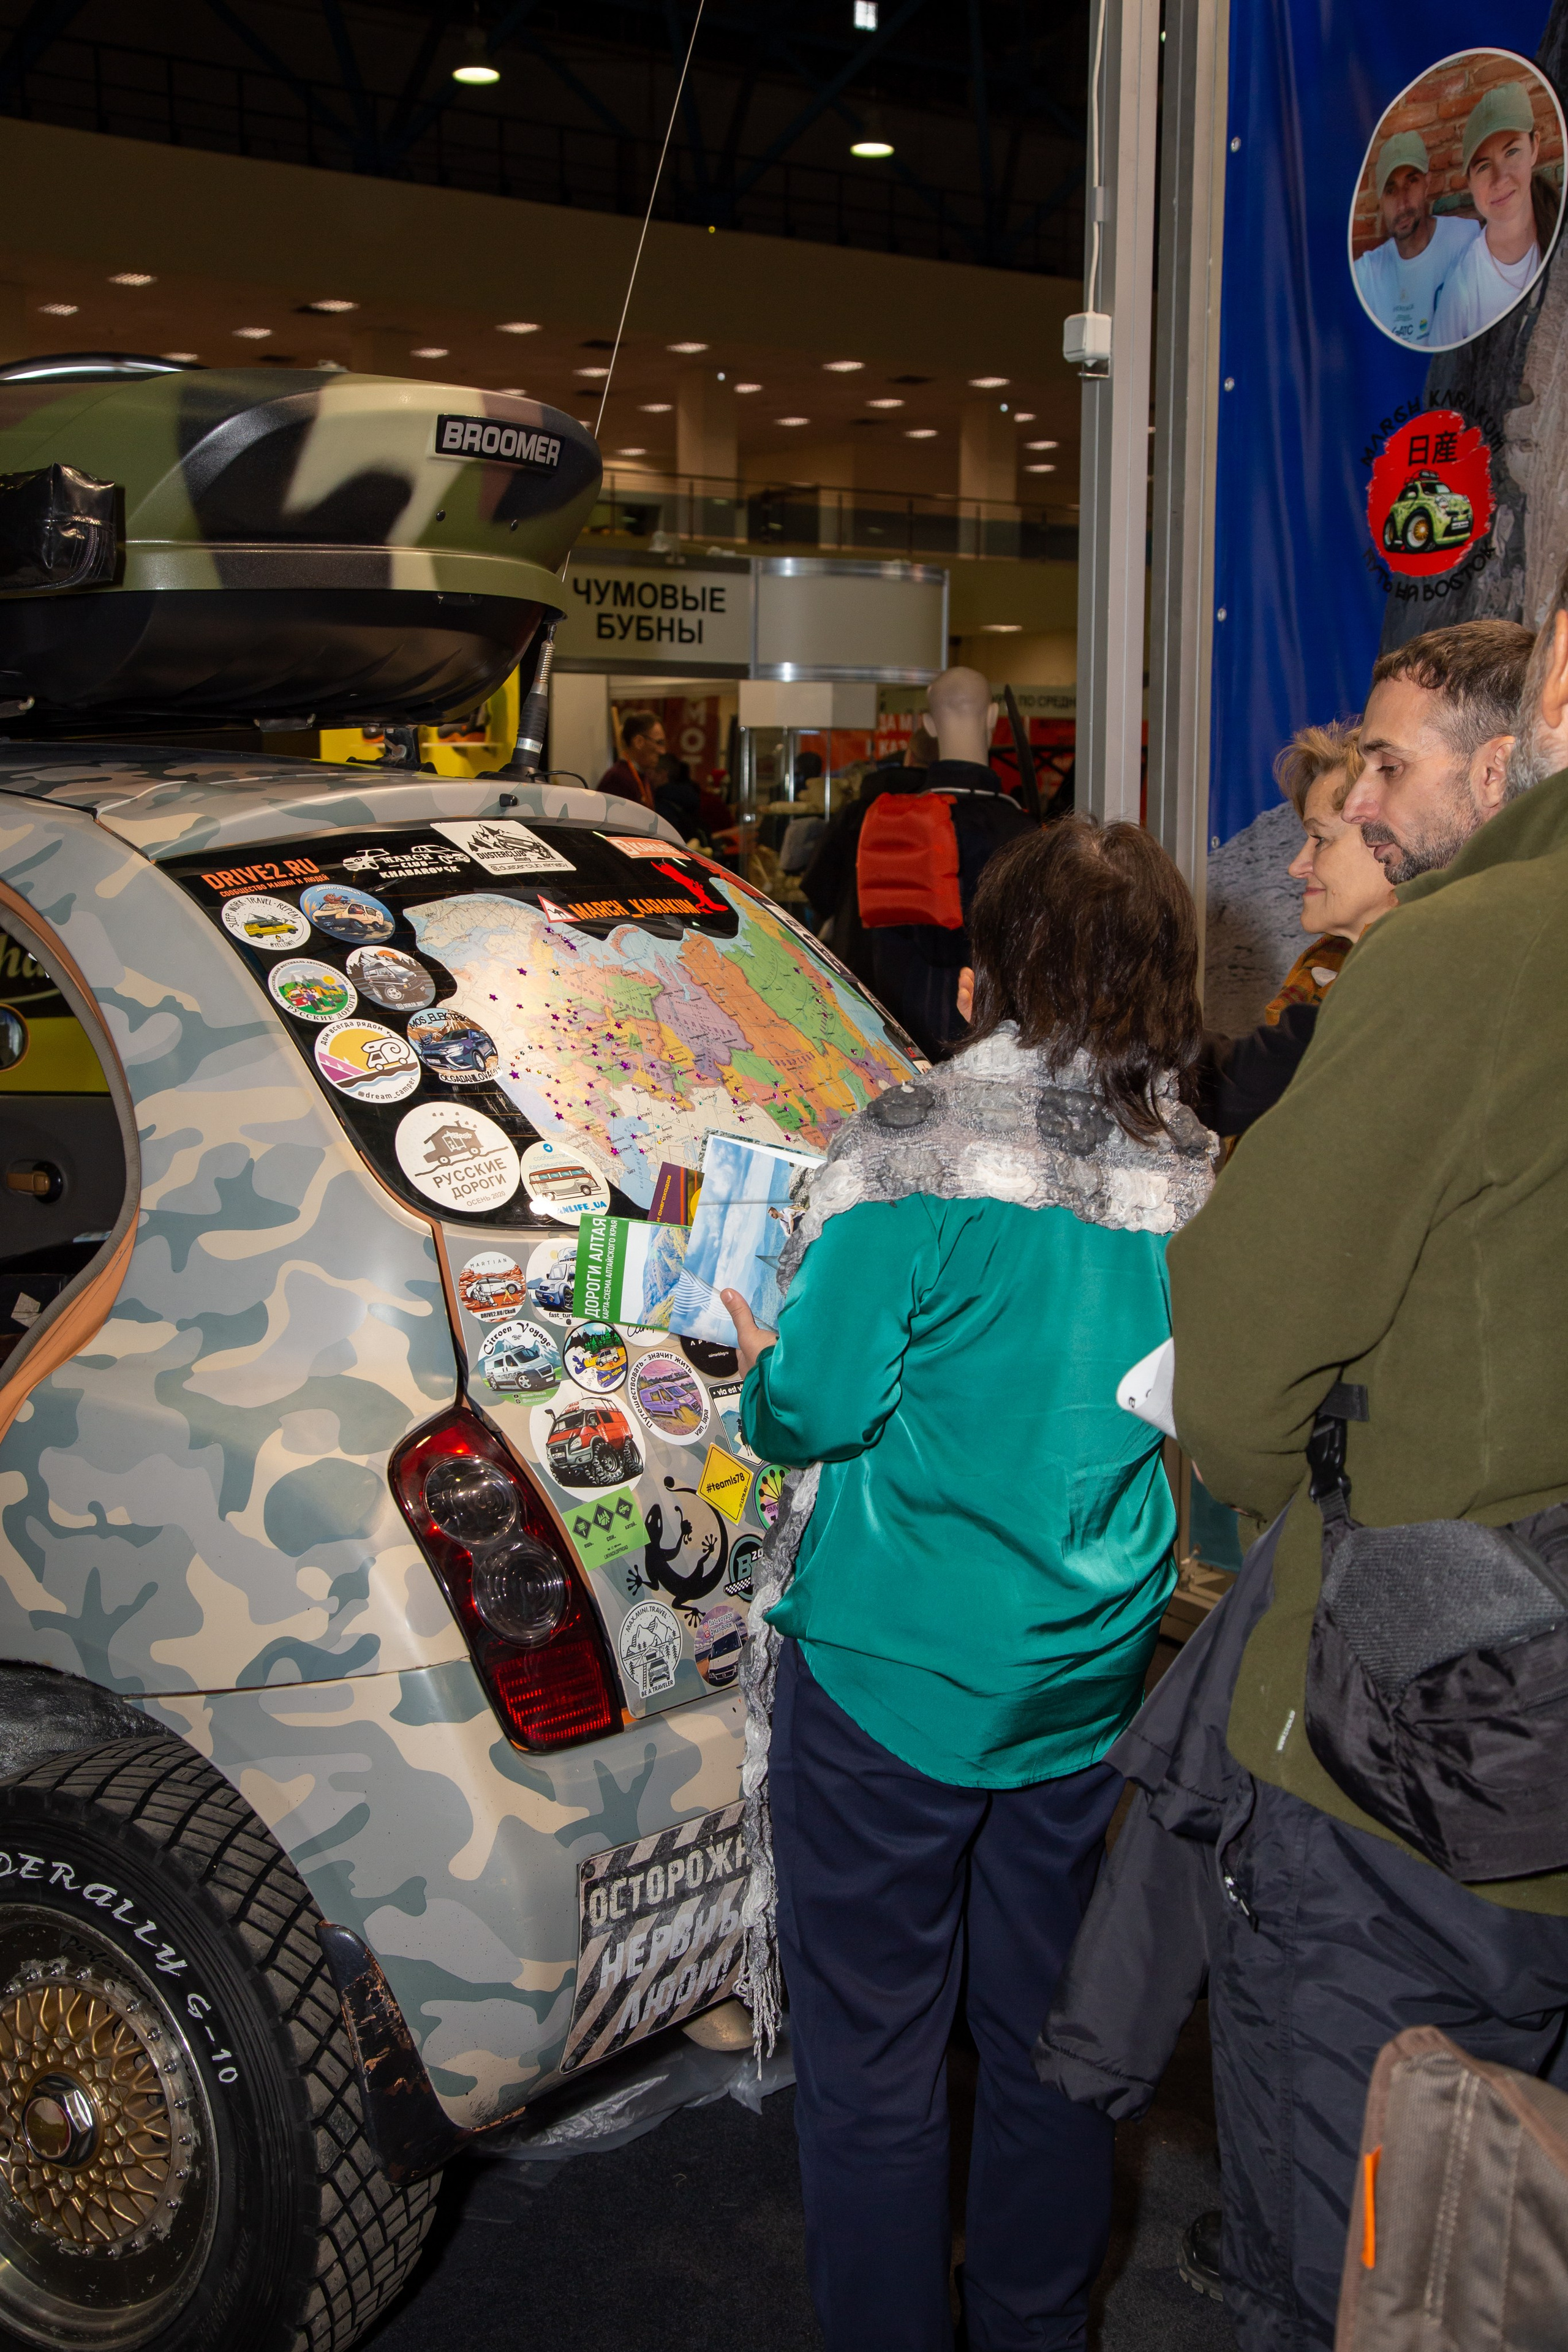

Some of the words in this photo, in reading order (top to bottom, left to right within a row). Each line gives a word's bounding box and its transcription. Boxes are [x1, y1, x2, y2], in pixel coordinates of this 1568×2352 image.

[442, 421, 562, 467] BROOMER
[1408, 431, 1458, 467] 日産
[572, 577, 726, 613] ЧУМОВЫЕ
[596, 614, 704, 644] БУБНЫ
[380, 853, 434, 864] MARCH
[476, 850, 527, 860] DUSTERCLUB
[201, 858, 320, 889] DRIVE2.RU
[219, 884, 268, 897] СООБЩЕСТВО
[268, 880, 296, 890] МАШИН
[304, 874, 331, 884] ЛЮДЕЙ
[379, 865, 461, 879] KHABAROVSK
[228, 899, 245, 912] WORK
[246, 897, 273, 906] TRAVEL
[277, 903, 303, 920] REPEAT
[225, 913, 239, 927] SLEEP
[279, 960, 306, 969] ФЕСТИВАЛЬ
[287, 1005, 335, 1021] РУССКИЕ
[337, 993, 356, 1020] ДОРОГИ
[320, 1032, 331, 1046] дом
[329, 1022, 355, 1034] всегда
[356, 1022, 383, 1031] рядом
[432, 1158, 507, 1188] РУССКИЕ
[451, 1174, 507, 1200] ДОРОГИ
[466, 1195, 491, 1207] ОСЕНЬ
[491, 1190, 506, 1200] 2020
[555, 1200, 607, 1216] ANLIFE_UA
[589, 1217, 607, 1262] АЛТАЯ
[610, 1219, 619, 1238] КРАЯ
[470, 1258, 508, 1268] MARTIAN
[605, 1238, 616, 1279] АЛТАЙСКОГО
[584, 1264, 601, 1319] ДОРОГИ
[602, 1278, 612, 1320] КАРТА-СХЕМА
[484, 1325, 513, 1355] Citroen
[516, 1322, 552, 1348] Voyage
[630, 1360, 653, 1429] Путешествовать
[648, 1351, 673, 1361] значит
[674, 1355, 693, 1374] жить
[695, 1408, 709, 1437] van_lapa
[706, 1472, 745, 1493] #teamls78
[625, 1605, 668, 1633] MAX.MINI.TRAVEL
[652, 1679, 674, 1693] TRAVELER
[587, 1833, 753, 1928] ОСТОРОЖН
[614, 1948, 731, 2036] ЛЮДИ!
